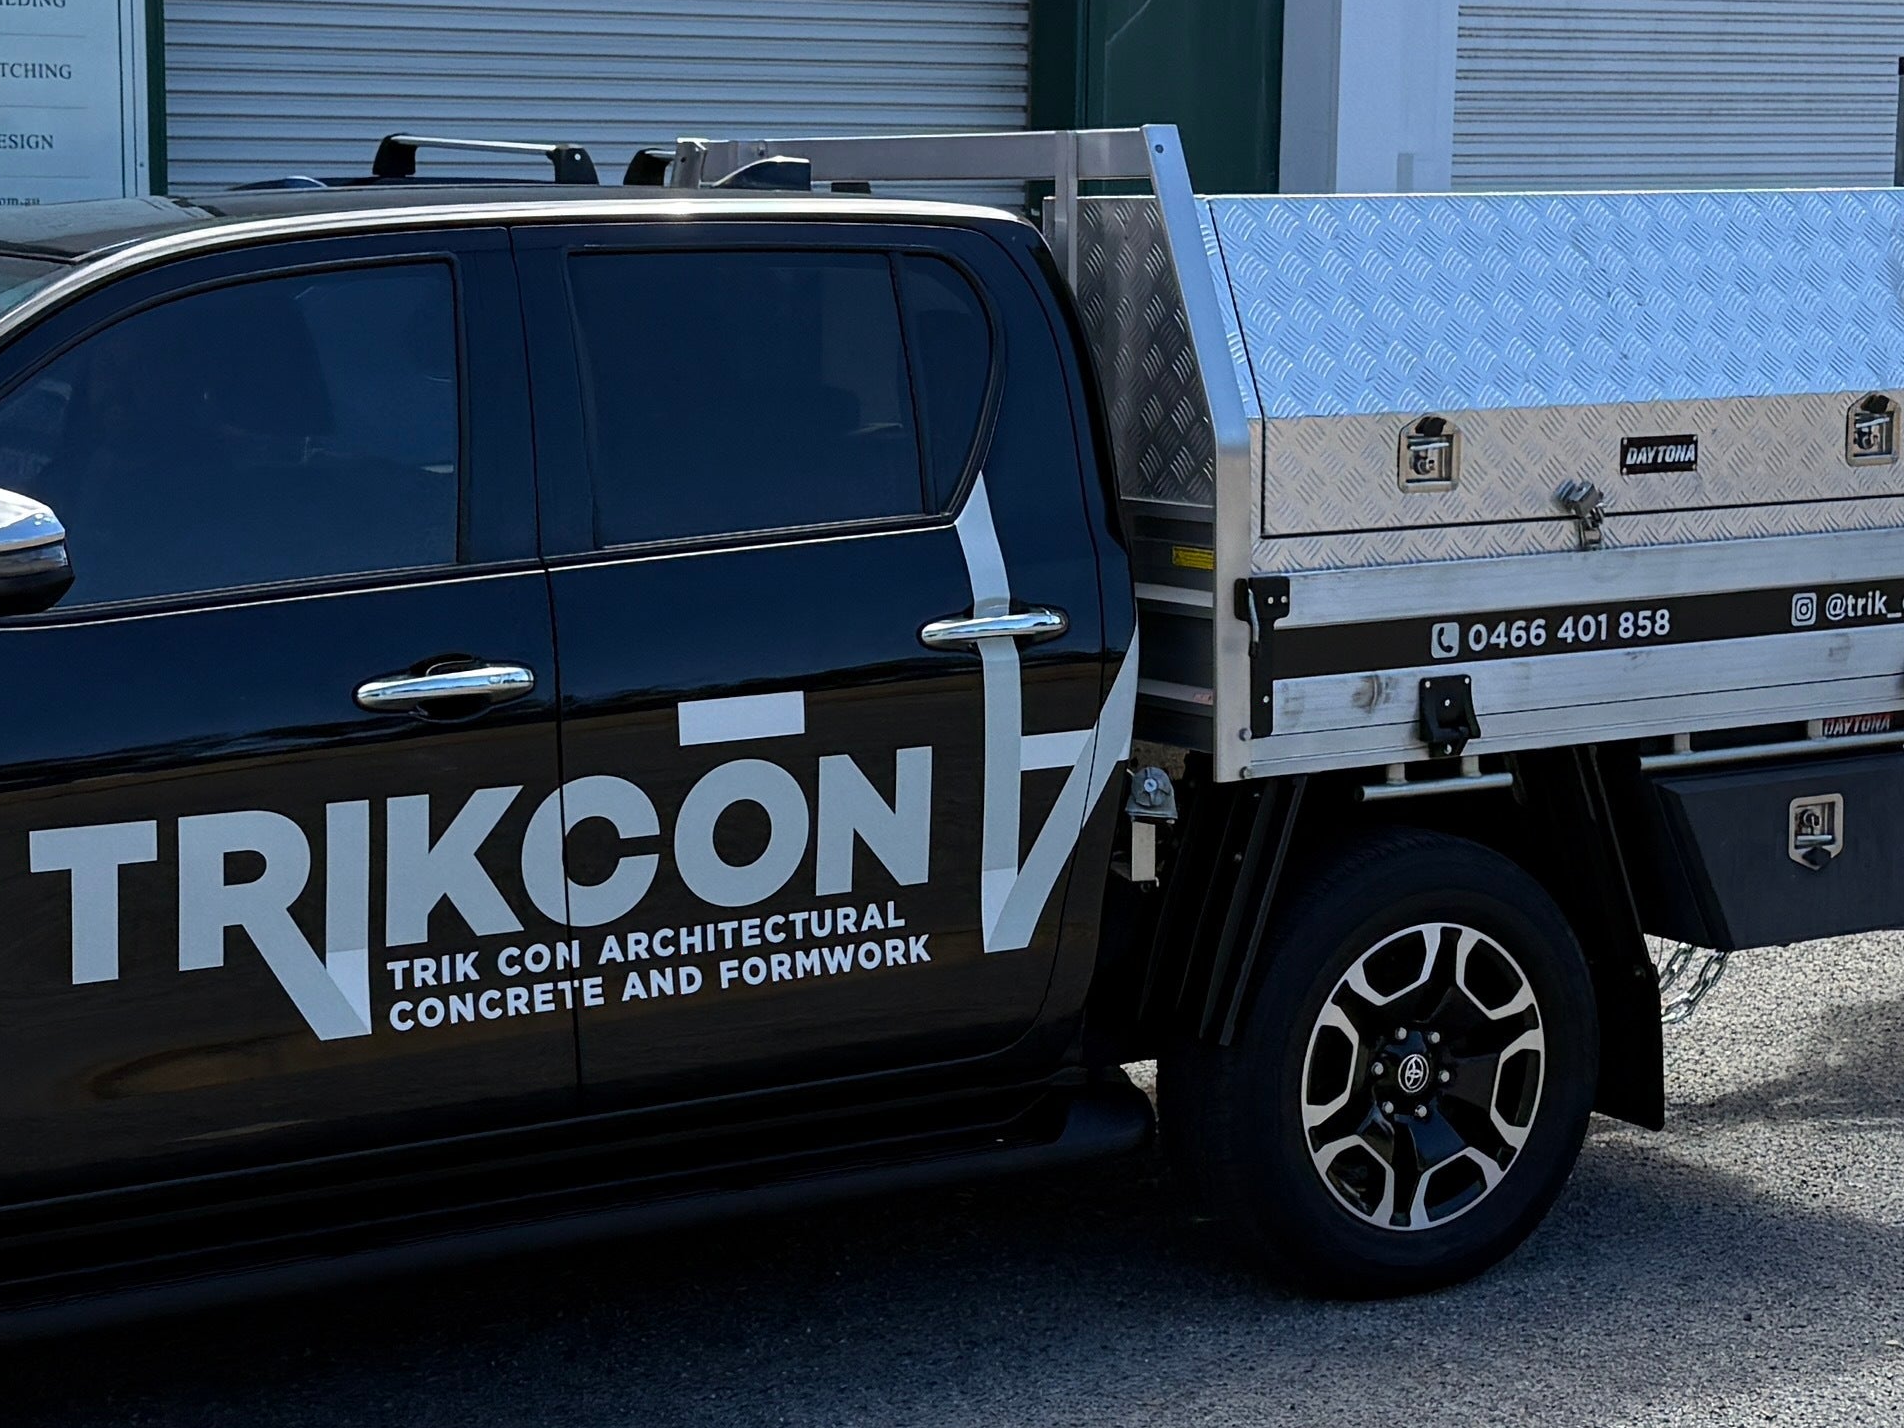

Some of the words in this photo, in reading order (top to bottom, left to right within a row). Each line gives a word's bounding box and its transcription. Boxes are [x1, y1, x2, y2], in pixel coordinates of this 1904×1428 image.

[1626, 444, 1696, 465] DAYTONA
[1468, 620, 1548, 651] 0466
[1557, 614, 1610, 645] 401
[1617, 608, 1671, 640] 858
[1824, 714, 1891, 736] DAYTONA
[387, 951, 481, 993] TRIK
[498, 940, 581, 981] CON
[599, 901, 906, 965] ARCHITECTURAL
[388, 980, 606, 1034] CONCRETE
[621, 966, 704, 1003] AND
[720, 933, 933, 990] FORMWORK
